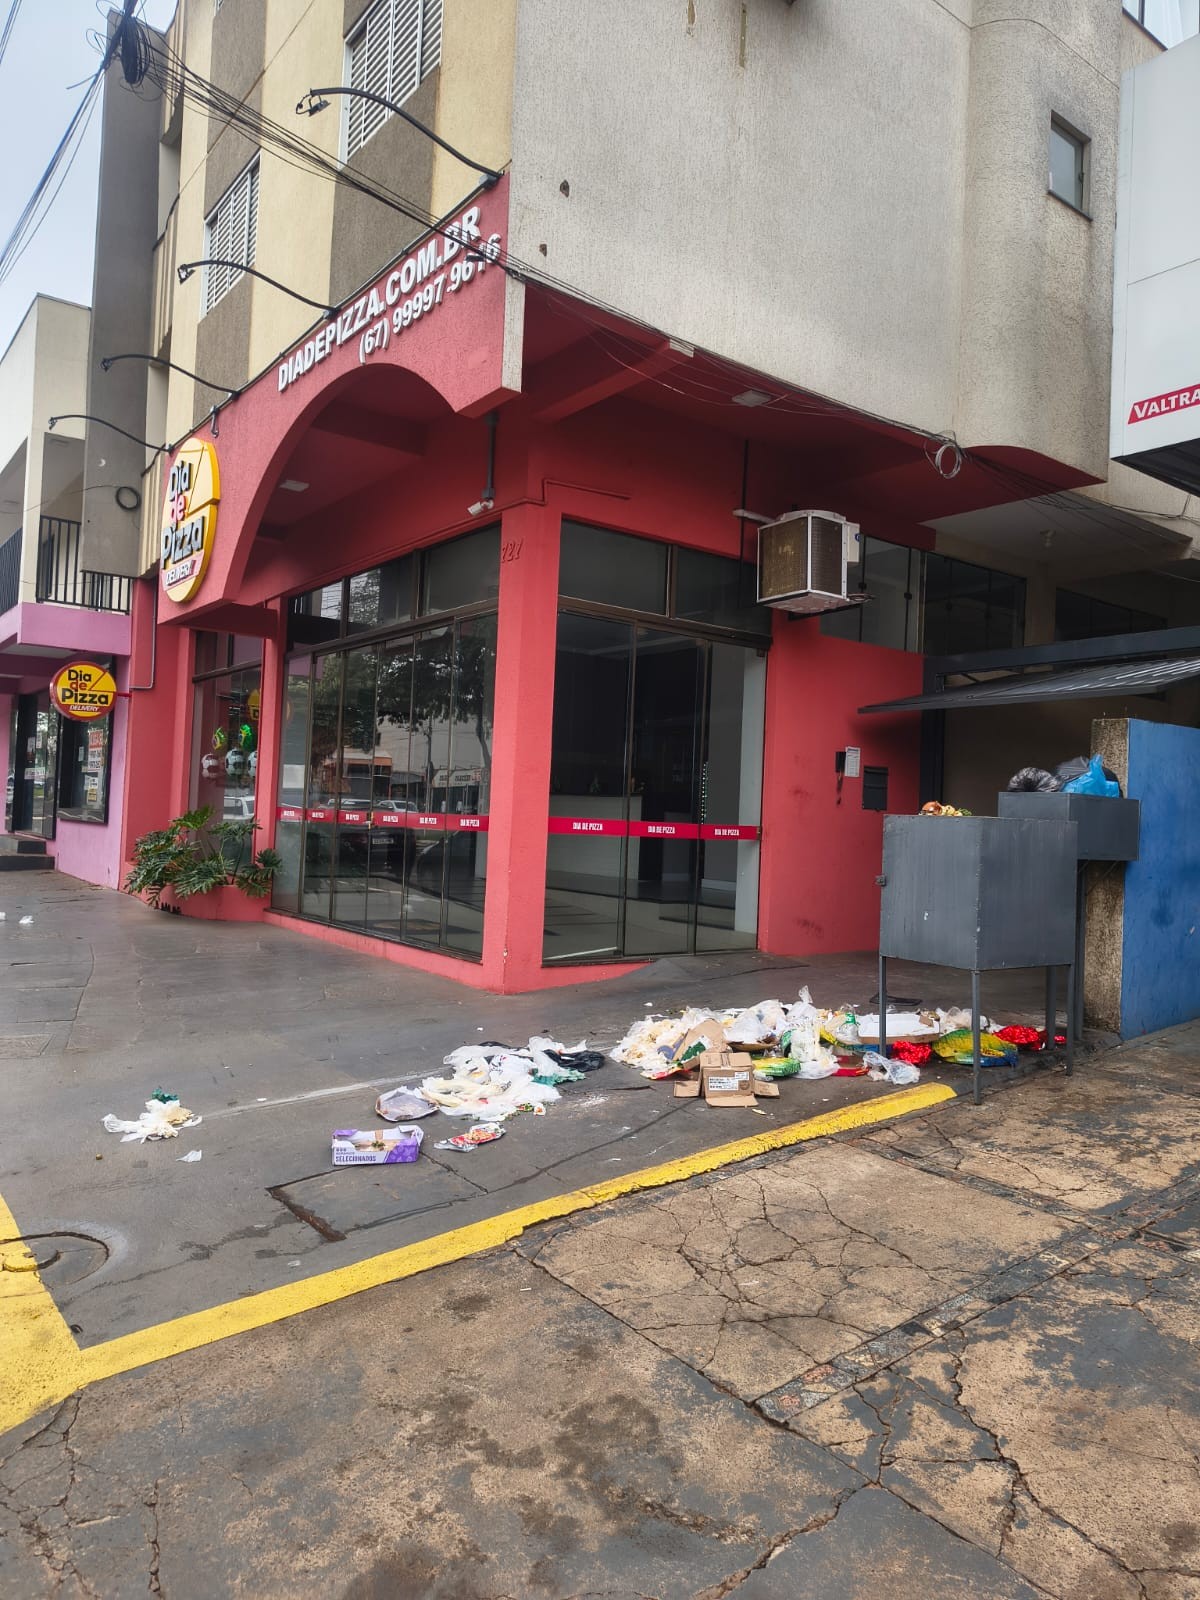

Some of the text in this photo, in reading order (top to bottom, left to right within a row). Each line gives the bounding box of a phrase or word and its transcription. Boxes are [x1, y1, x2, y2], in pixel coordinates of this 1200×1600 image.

[278, 206, 481, 392] DIADEPIZZA.COM.BR
[359, 318, 390, 364] (67)
[1133, 388, 1200, 419] VALTRA
[170, 460, 192, 502] Dia
[170, 490, 187, 524] de
[160, 515, 205, 570] Pizza
[67, 669, 92, 682] Dia
[69, 678, 88, 692] de
[61, 688, 109, 705] Pizza
[70, 704, 99, 712] DELIVERY
[589, 823, 603, 831] PIZZA
